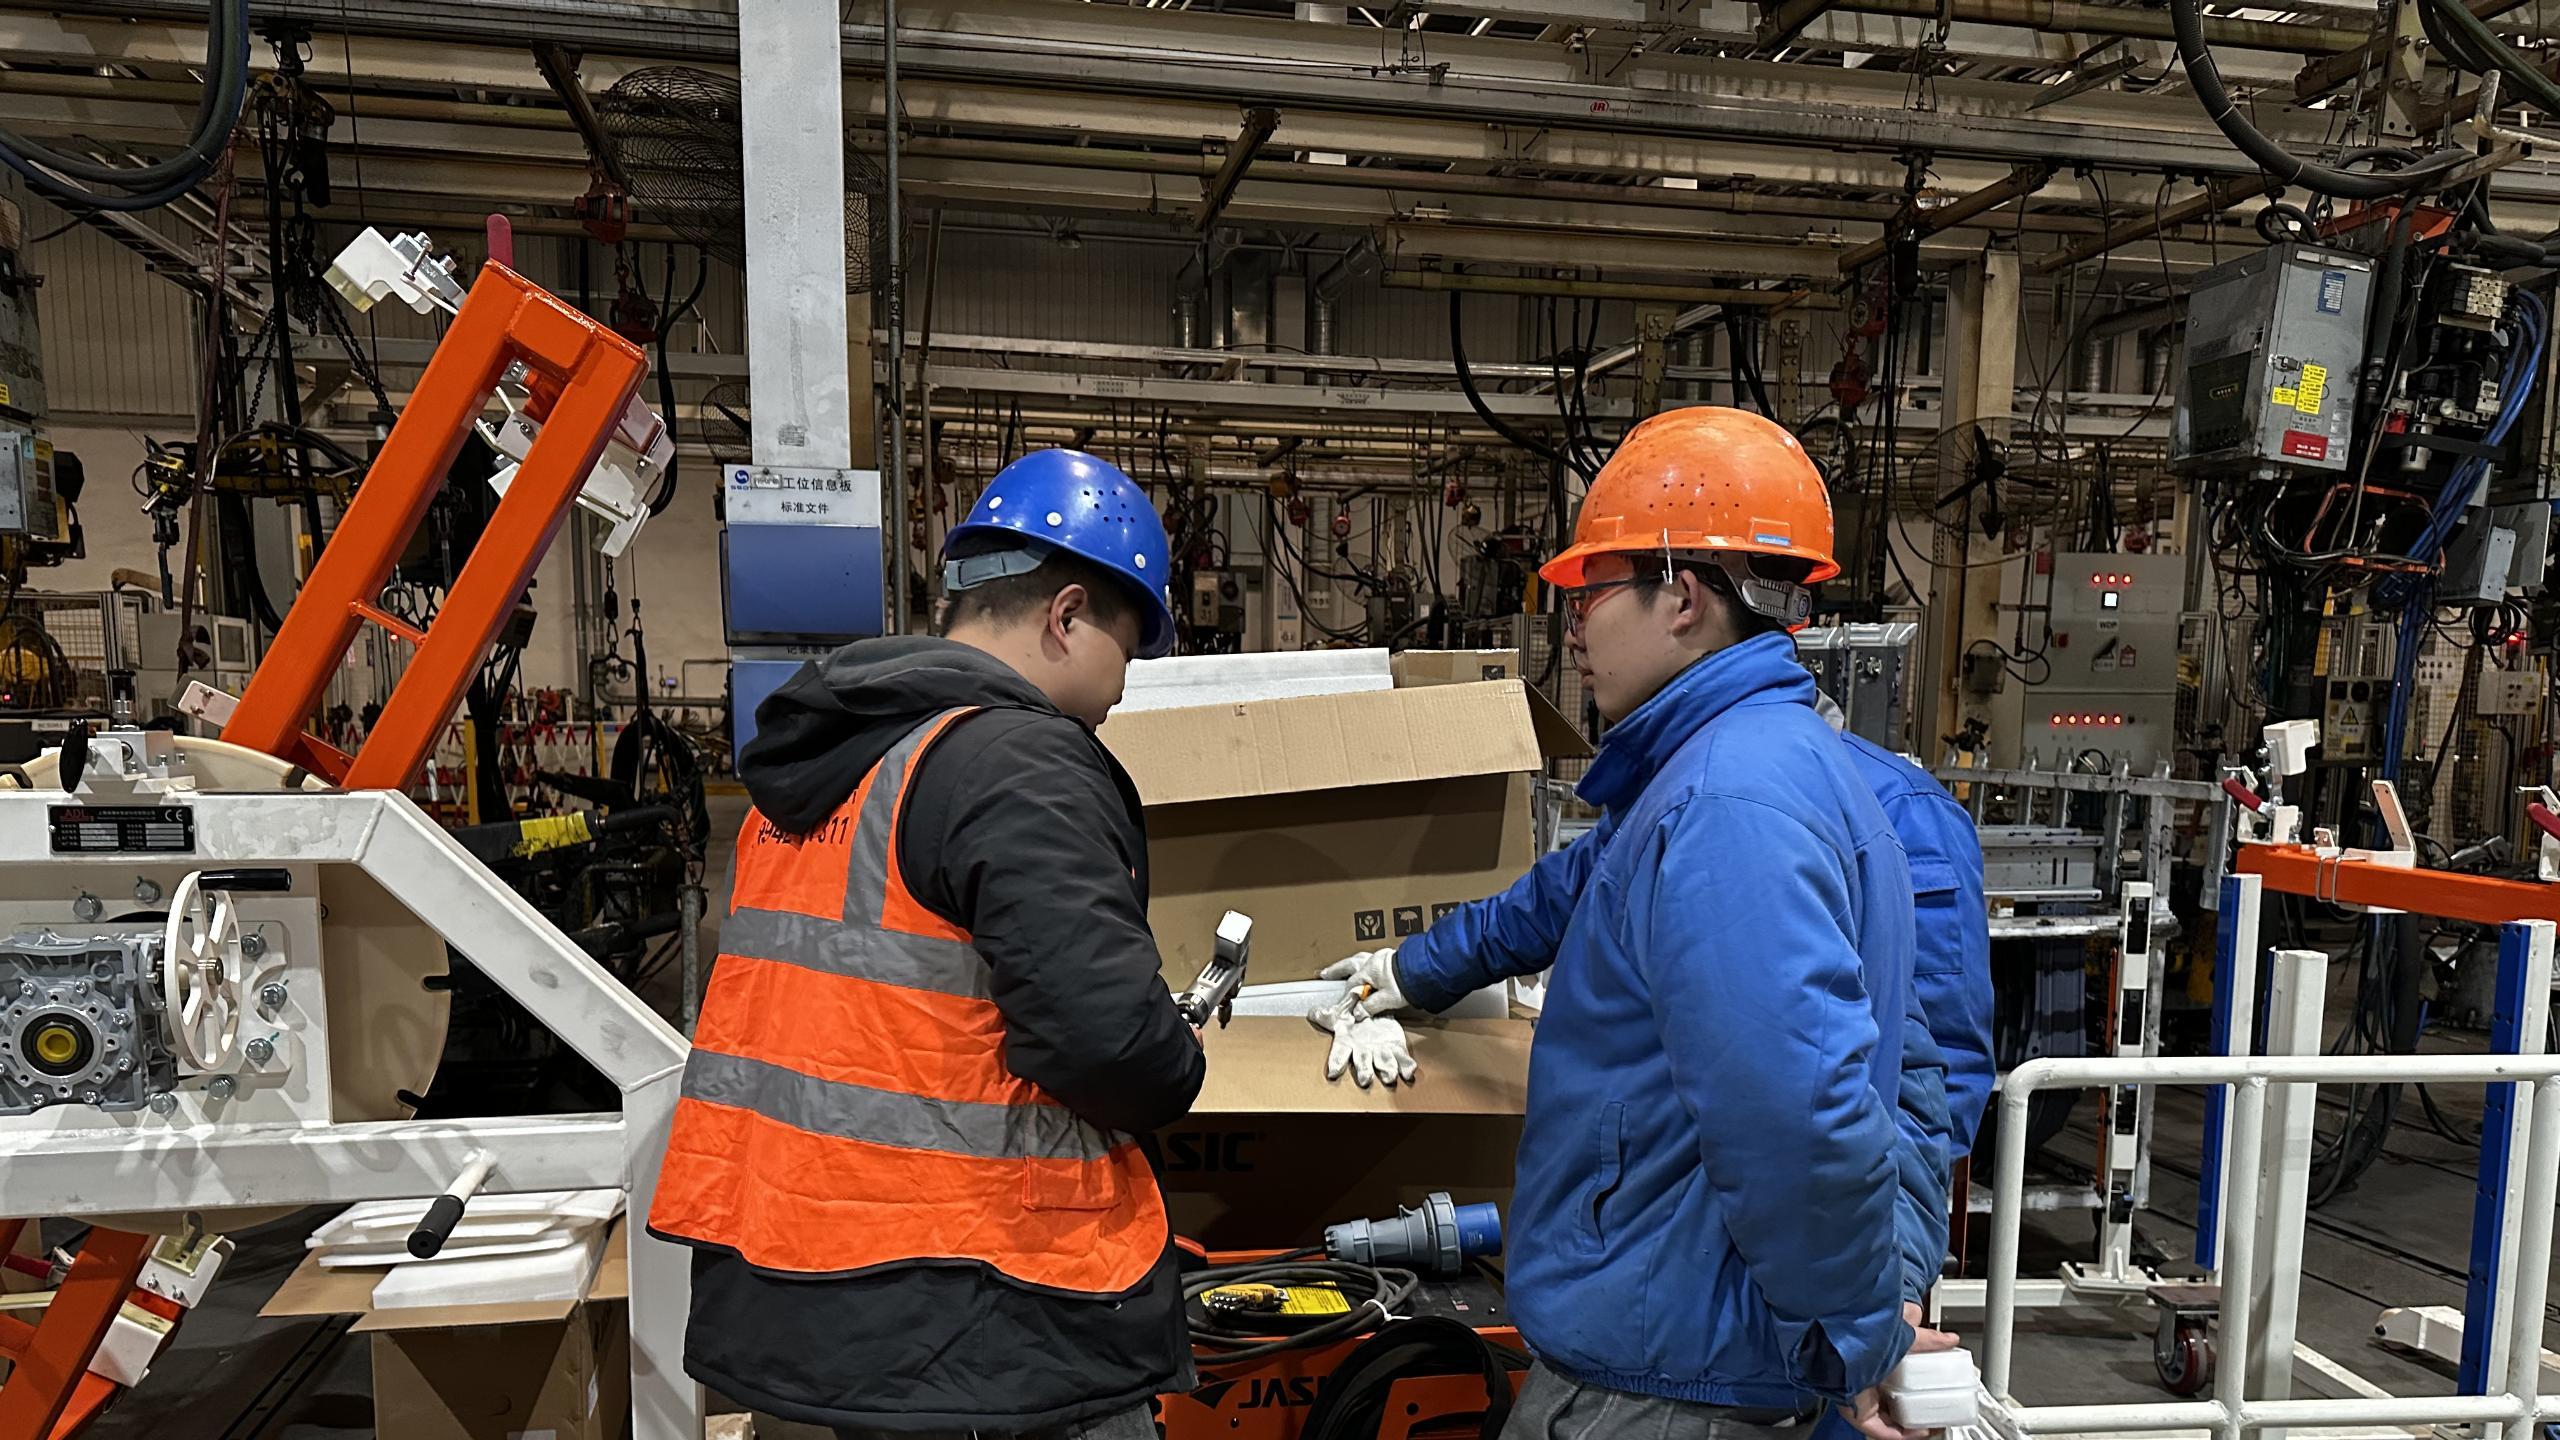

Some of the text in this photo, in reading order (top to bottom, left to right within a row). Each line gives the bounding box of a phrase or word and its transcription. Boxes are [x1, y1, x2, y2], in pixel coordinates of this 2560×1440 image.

[783, 477, 853, 493] 工位信息板
[780, 502, 830, 514] 标准文件
